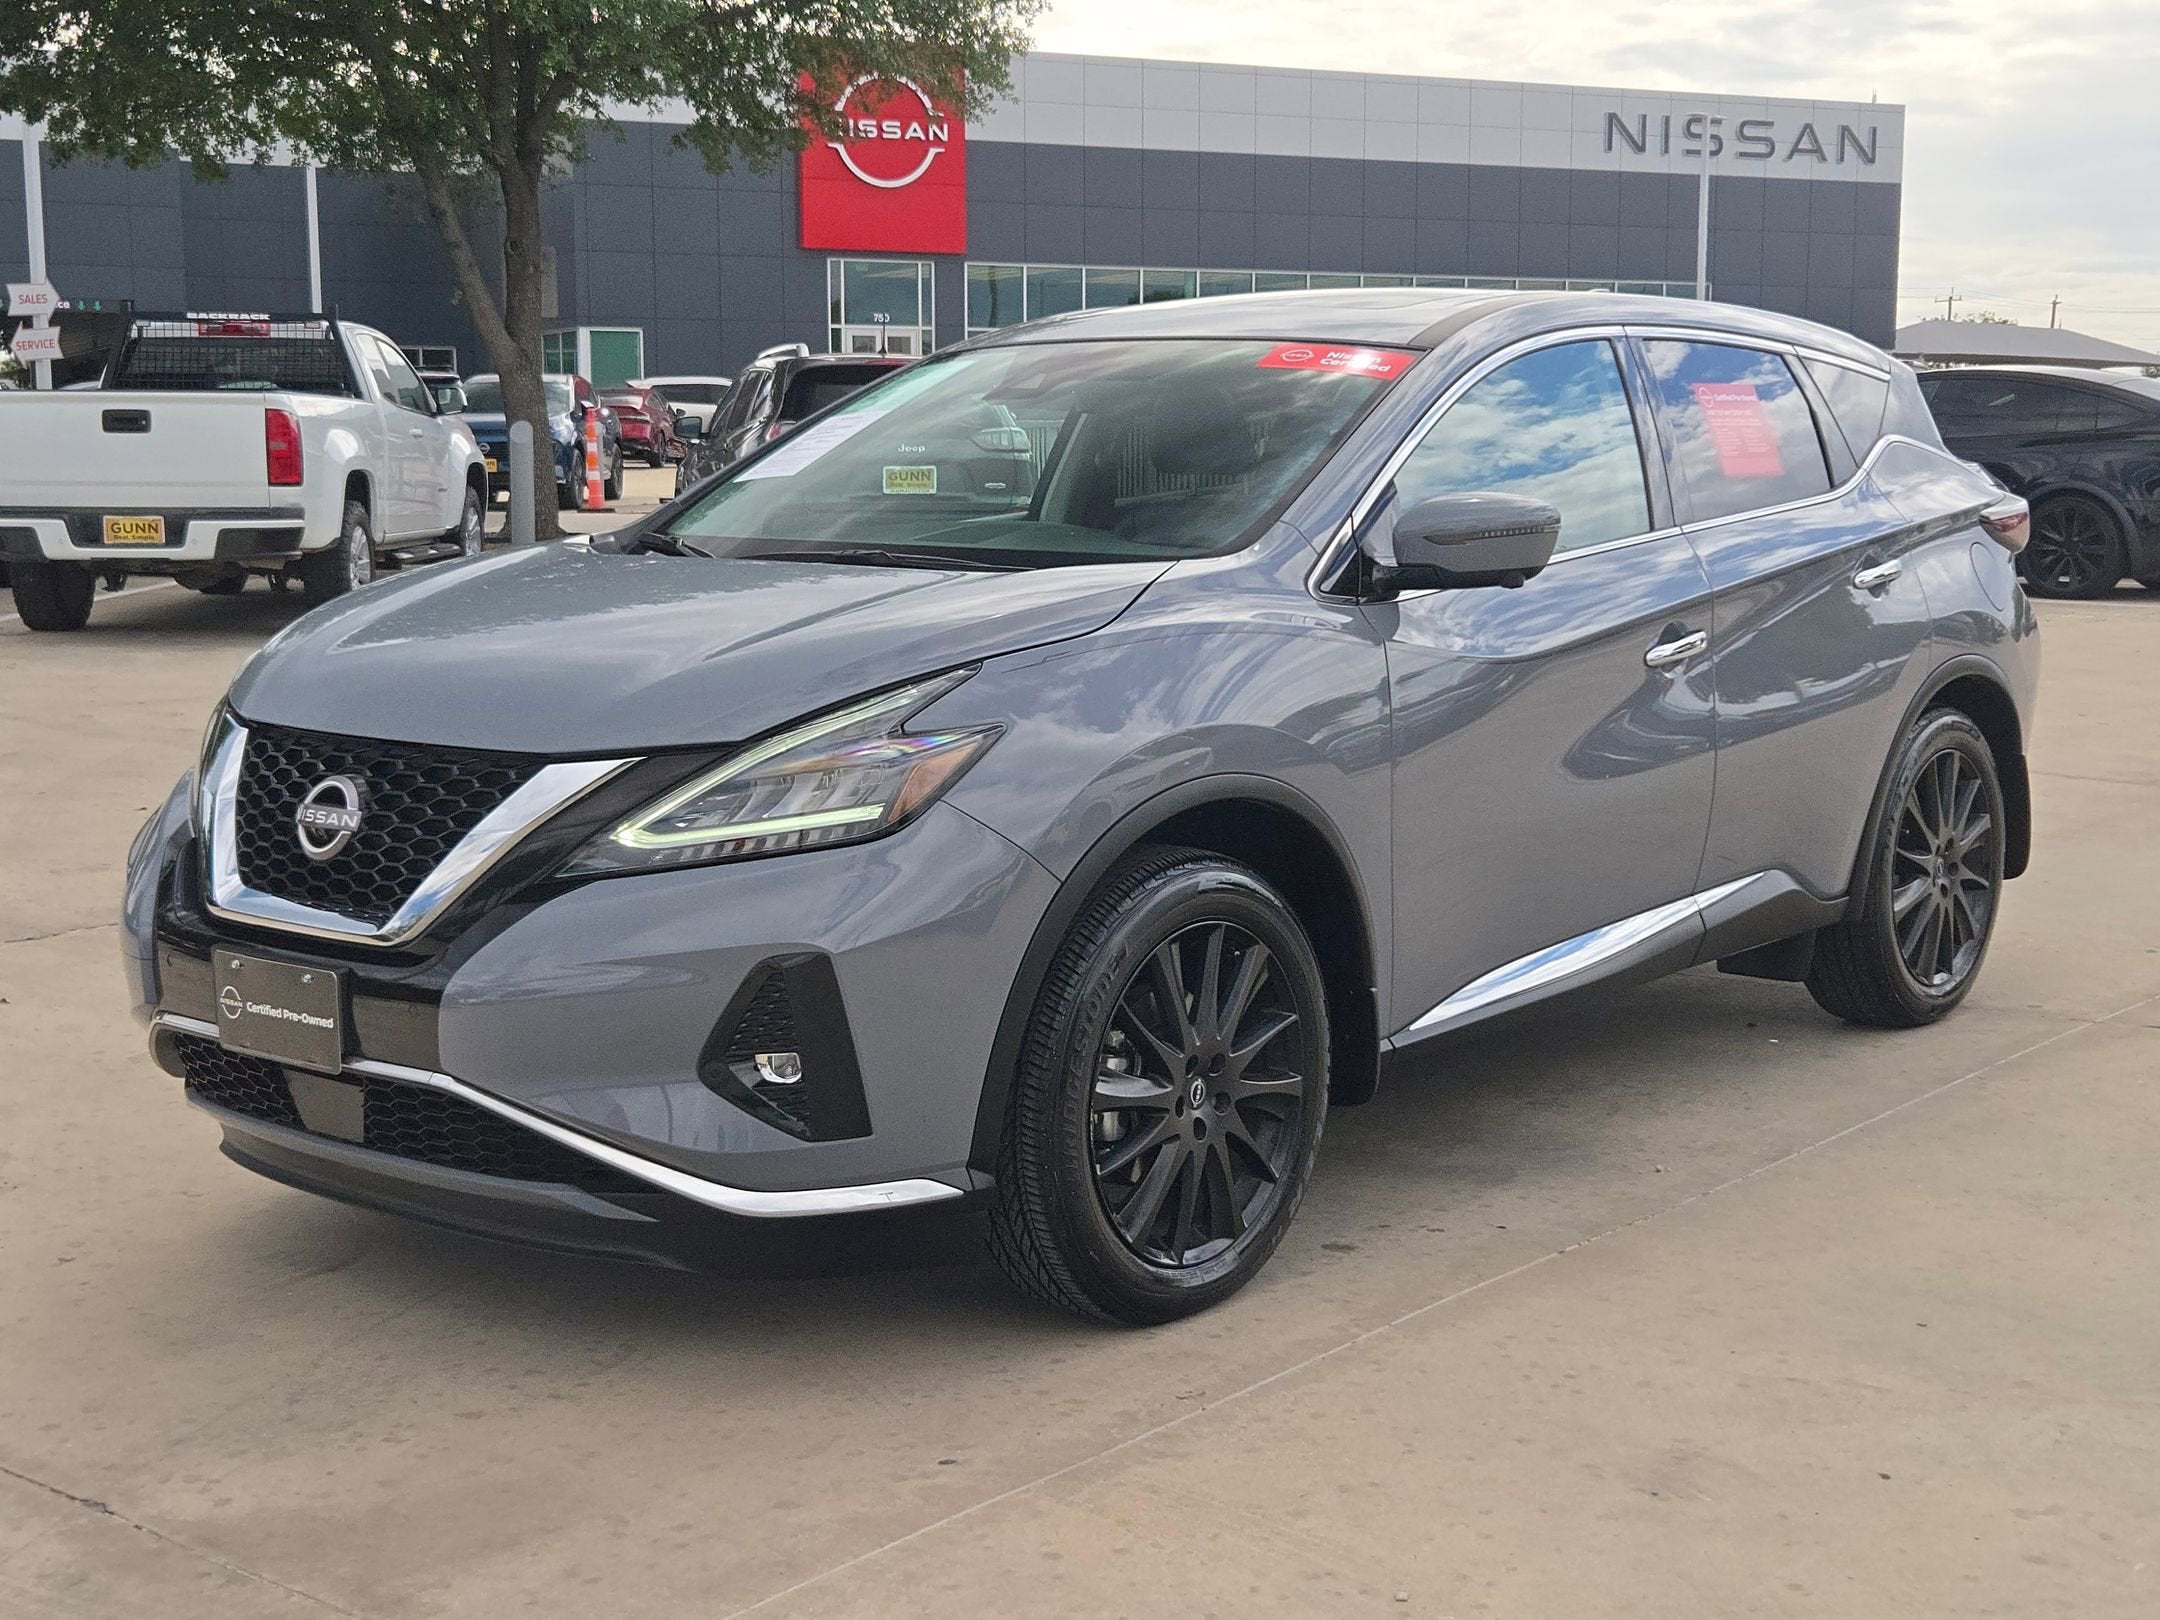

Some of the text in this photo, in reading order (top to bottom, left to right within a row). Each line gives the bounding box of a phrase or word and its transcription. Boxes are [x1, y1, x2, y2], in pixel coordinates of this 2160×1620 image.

[1604, 111, 1878, 166] NISSAN
[19, 294, 47, 304] SALES
[16, 339, 55, 351] SERVICE
[897, 443, 926, 453] Jeep
[888, 471, 931, 481] GUNN
[111, 522, 159, 534] GUNN
[246, 1001, 282, 1018] Certified
[283, 1009, 334, 1029] Pre-Owned
